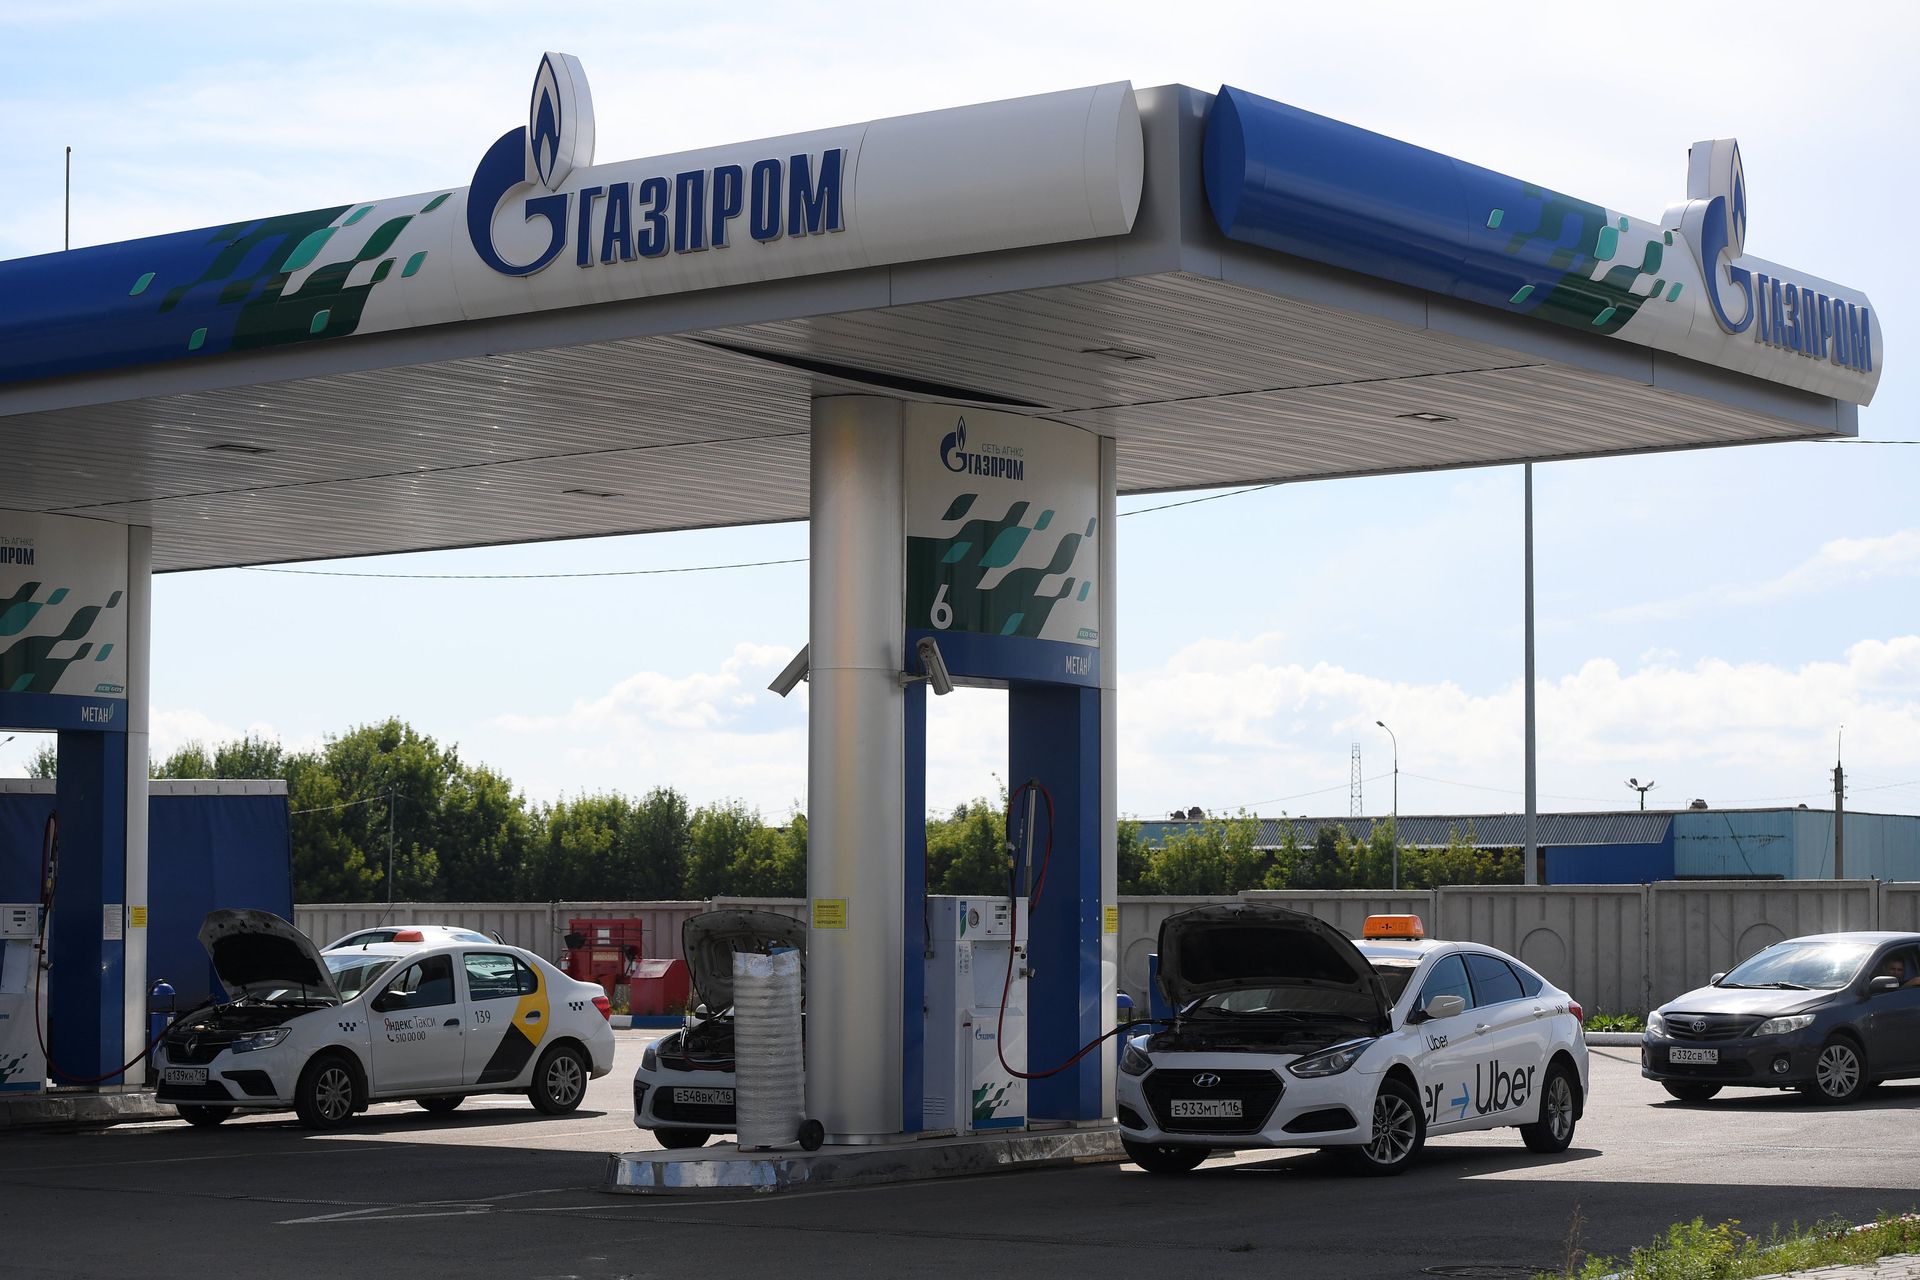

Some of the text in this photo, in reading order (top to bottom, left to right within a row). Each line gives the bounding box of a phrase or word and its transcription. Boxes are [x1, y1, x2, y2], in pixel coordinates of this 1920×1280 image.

[576, 148, 847, 268] ГАЗПРОМ
[1754, 272, 1872, 373] ГАЗПРОМ
[981, 443, 1024, 457] СЕТЬ АГНКС
[968, 453, 1024, 481] ГАЗПРОМ
[0, 536, 10, 545] ТЬ
[0, 546, 35, 565] ПРОМ
[930, 583, 953, 630] 6
[1065, 655, 1088, 676] МЕТАН
[81, 706, 109, 723] МЕТАН
[384, 1015, 436, 1031] Яндекс Такси
[475, 1010, 491, 1024] 139
[1426, 1034, 1449, 1051] Uber
[715, 1090, 731, 1100] 716
[1475, 1060, 1536, 1115] Uber
[1174, 1101, 1239, 1115] Е933МТ 116
